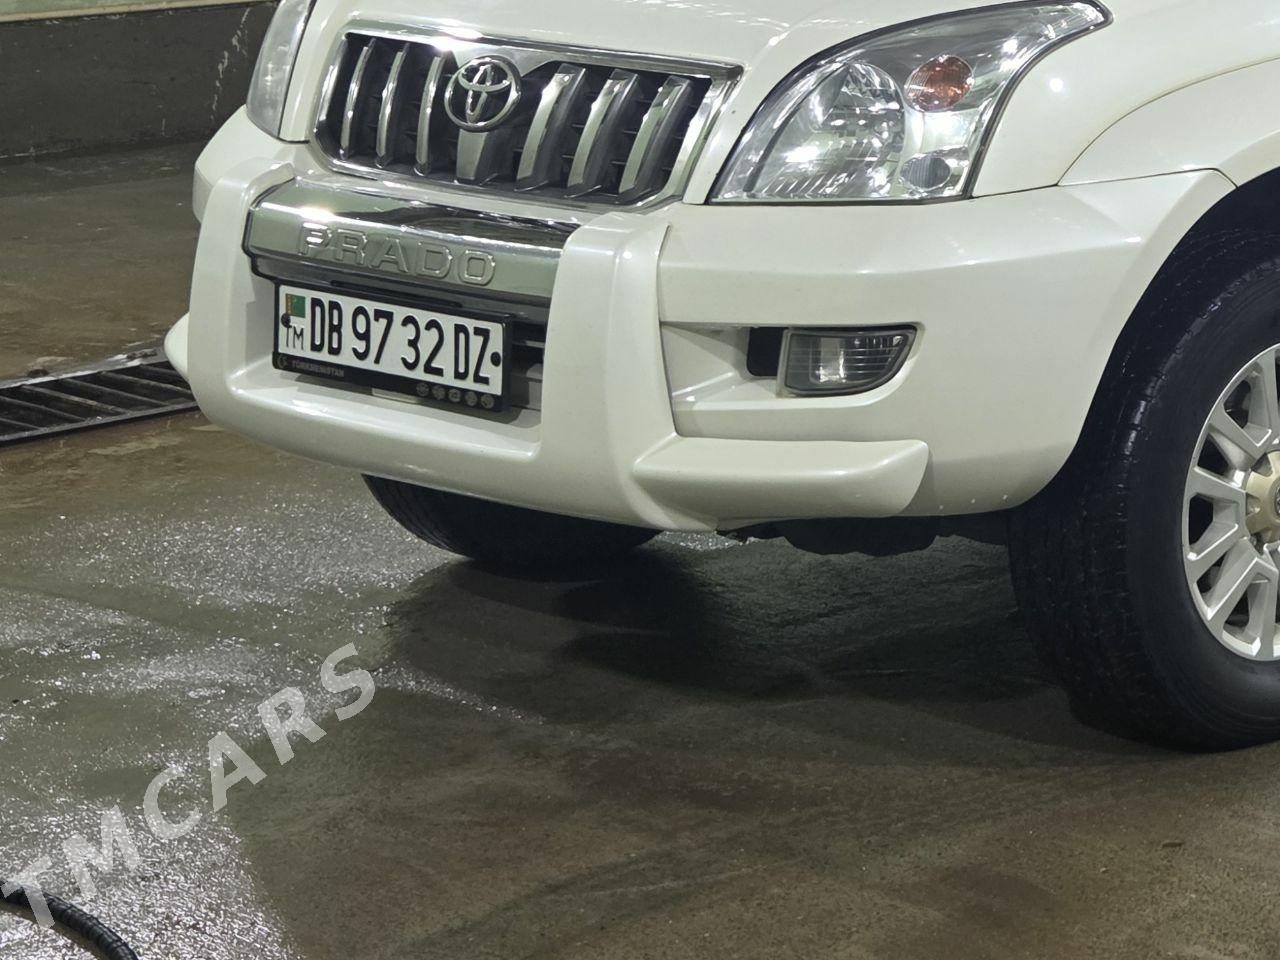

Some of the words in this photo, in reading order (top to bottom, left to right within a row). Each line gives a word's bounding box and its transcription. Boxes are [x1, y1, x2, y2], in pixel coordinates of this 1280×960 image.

[300, 222, 496, 286] PRADO
[310, 297, 343, 355] DB
[454, 324, 491, 385] DZ
